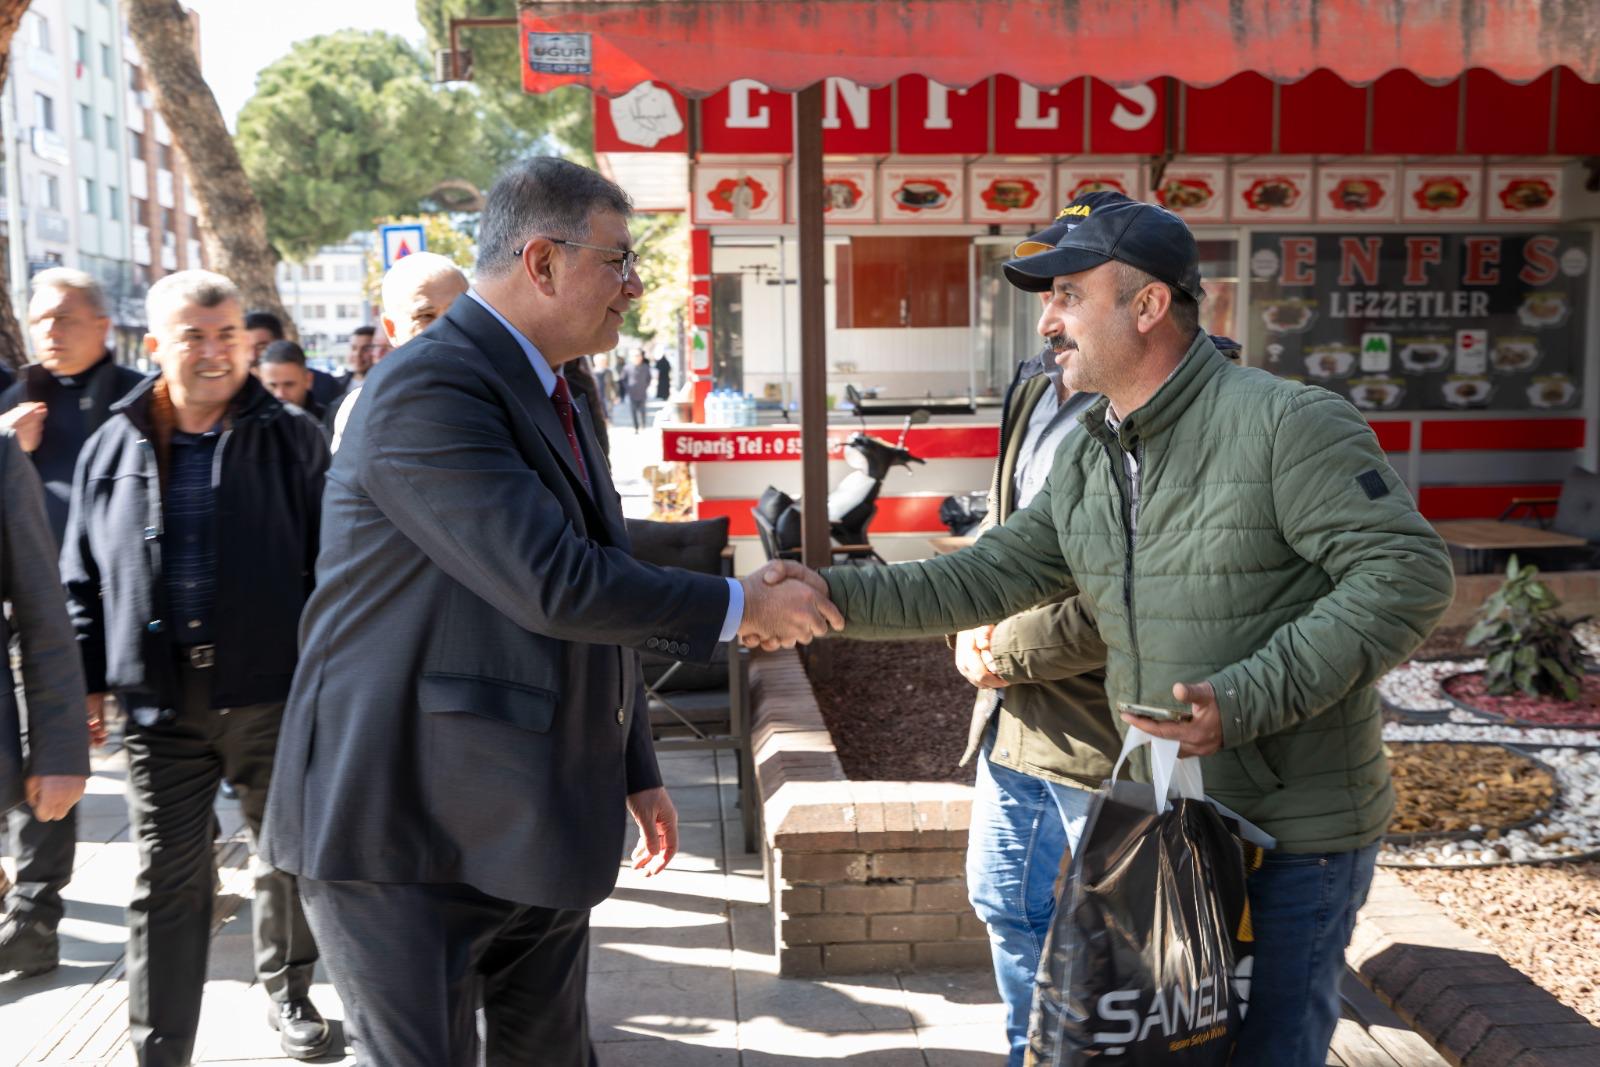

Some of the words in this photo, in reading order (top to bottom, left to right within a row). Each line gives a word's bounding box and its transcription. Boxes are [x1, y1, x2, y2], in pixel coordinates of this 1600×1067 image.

[1279, 236, 1560, 286] ENFES
[1329, 291, 1490, 319] LEZZETLER
[736, 436, 762, 454] Tel
